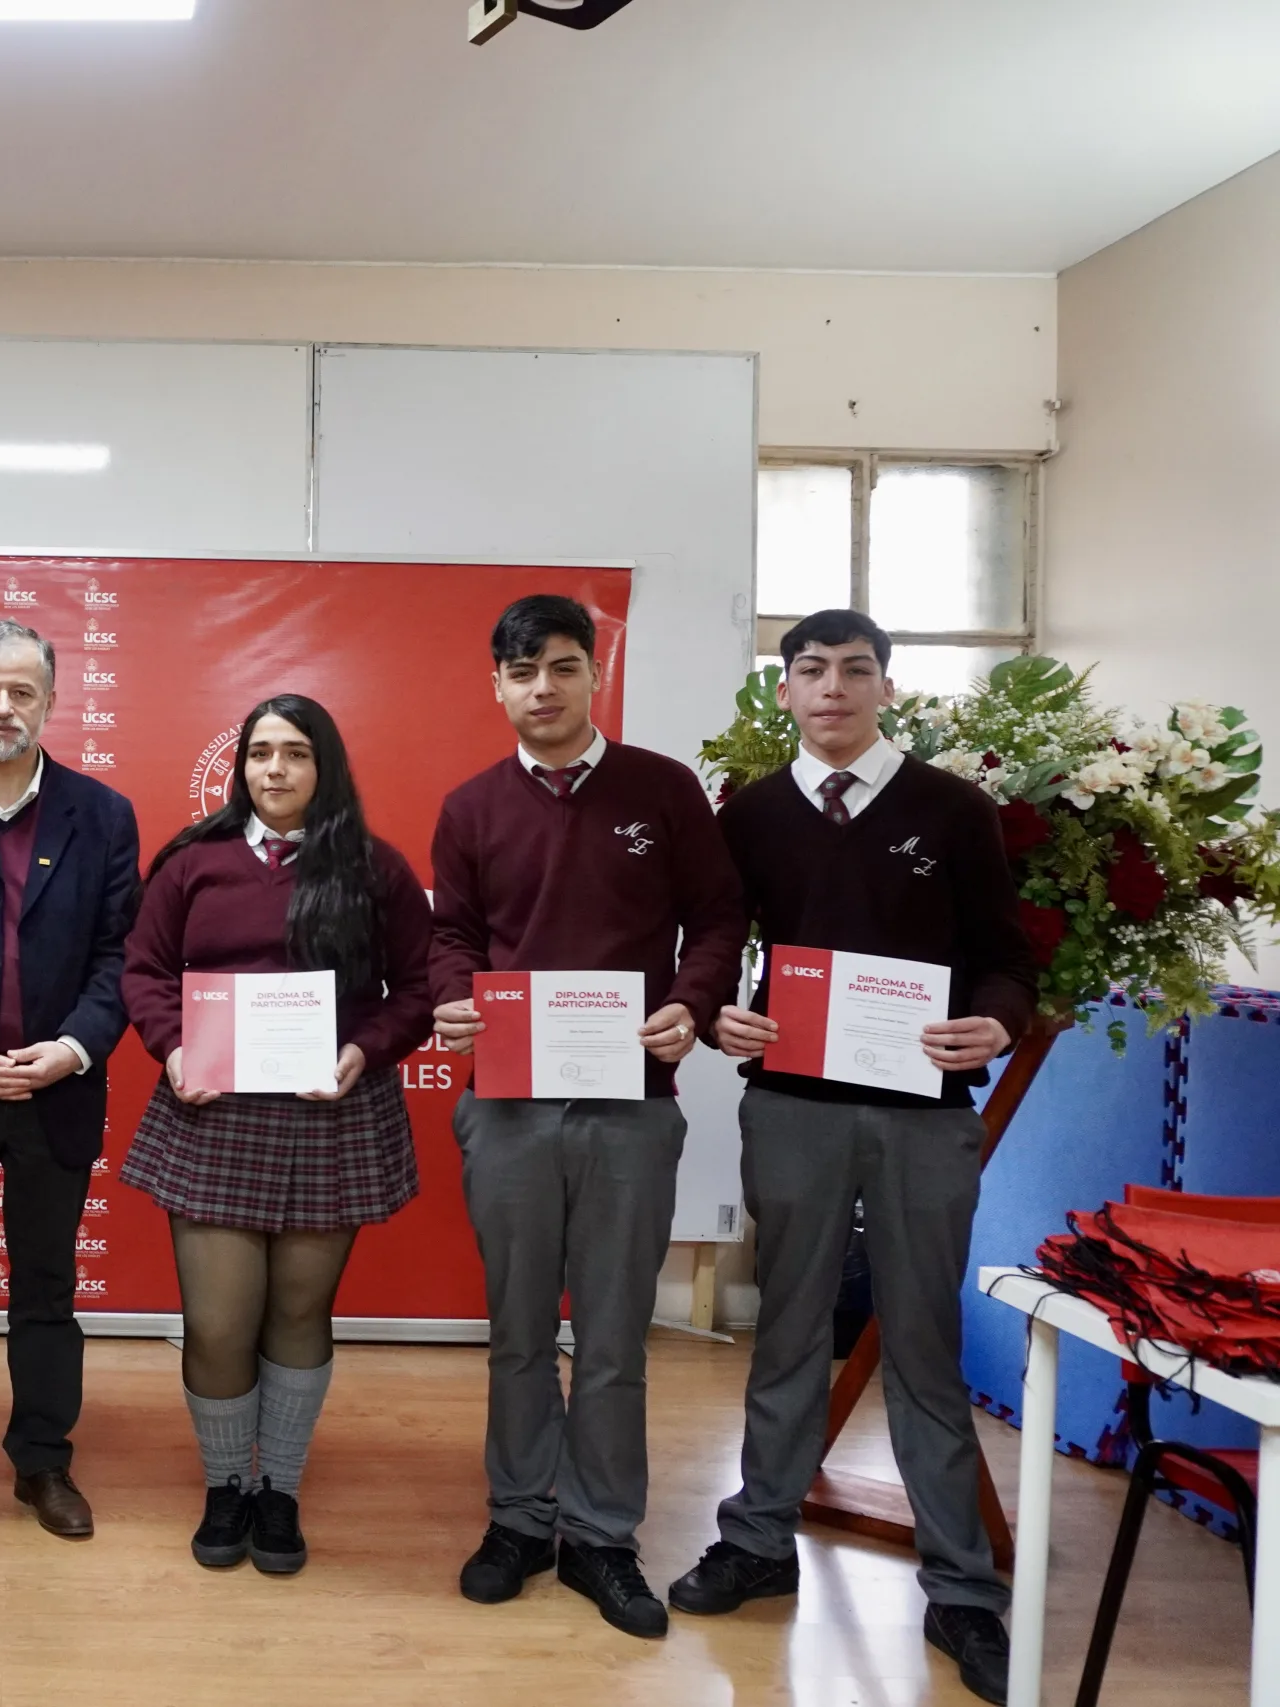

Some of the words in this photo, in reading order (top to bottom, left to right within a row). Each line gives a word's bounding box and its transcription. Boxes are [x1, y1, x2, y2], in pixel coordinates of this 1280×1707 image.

[3, 590, 37, 602] UCSC
[84, 592, 117, 604] UCSC
[83, 632, 117, 644] UCSC
[83, 672, 116, 684] UCSC
[82, 712, 115, 724] UCSC
[81, 752, 115, 764] UCSC
[614, 821, 649, 838] M
[889, 836, 921, 855] M
[794, 966, 824, 979] UCSC
[856, 974, 908, 990] DIPLOMA
[909, 981, 925, 992] DE
[202, 991, 229, 1001] UCSC
[256, 992, 300, 1000] DIPLOMA
[302, 990, 315, 999] DE
[495, 990, 524, 1000] UCSC
[555, 990, 603, 1000] DIPLOMA
[606, 990, 621, 1000] DE
[847, 983, 933, 1003] PARTICIPACIÓN
[548, 999, 628, 1010] PARTICIPACIÓN
[397, 1064, 452, 1089] LES
[91, 1158, 109, 1169] SC
[83, 1198, 108, 1210] CSC
